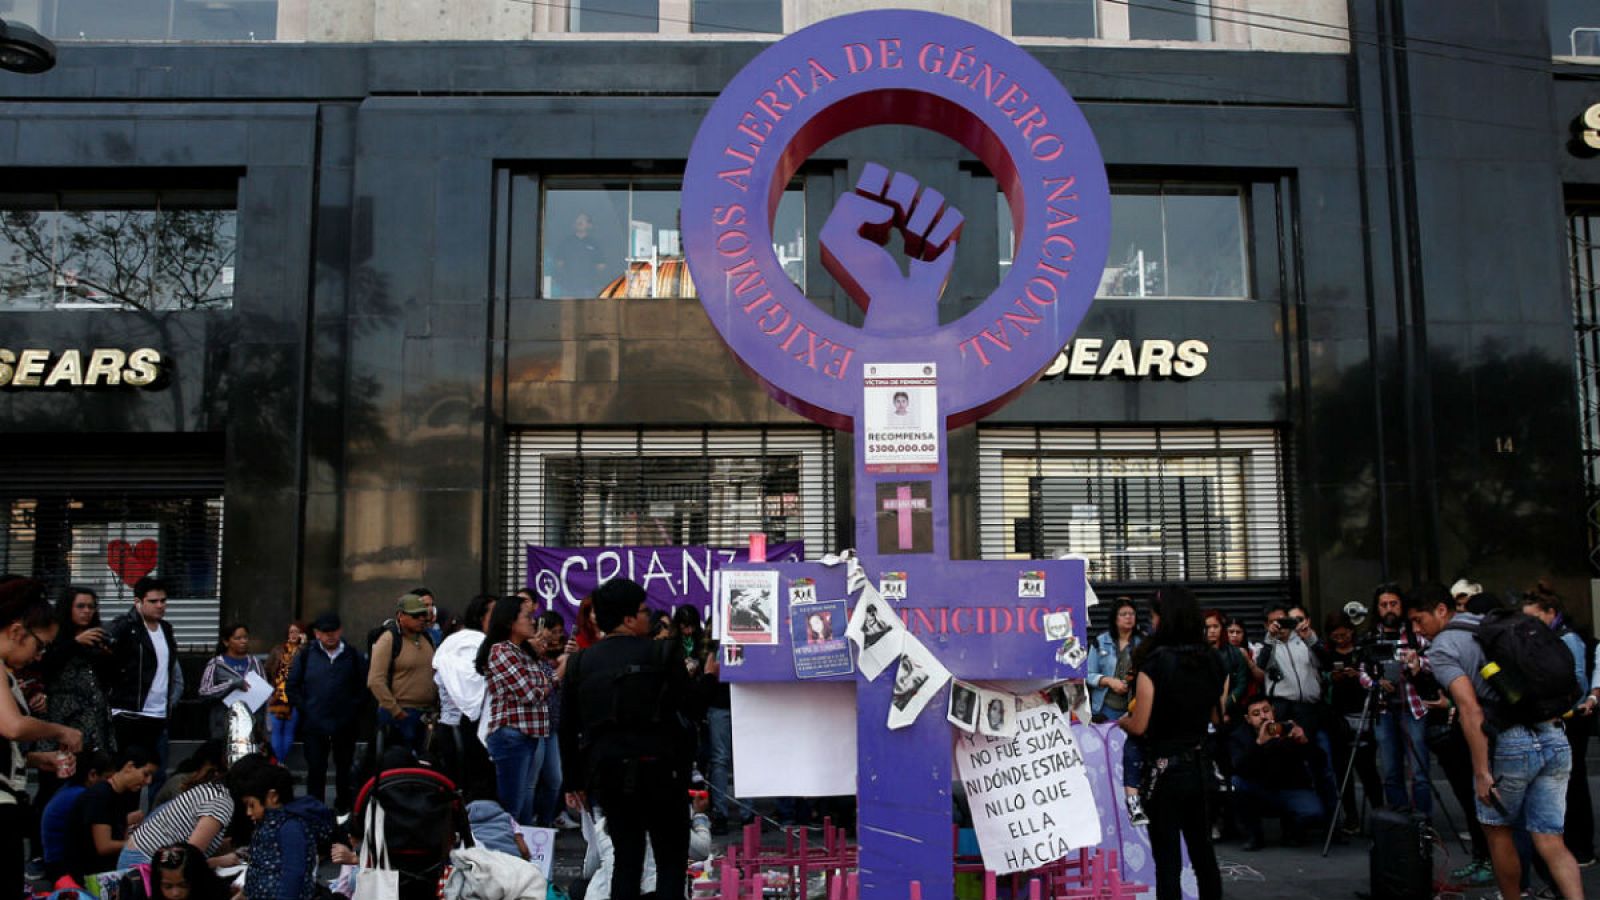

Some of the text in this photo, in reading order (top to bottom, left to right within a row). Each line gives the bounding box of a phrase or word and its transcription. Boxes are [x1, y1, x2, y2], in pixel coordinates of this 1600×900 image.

[714, 39, 1079, 381] EXIGIMOS ALERTA DE GÉNERO NACIONAL
[867, 431, 935, 441] RECOMPENSA
[868, 443, 936, 453] $300,000.00
[966, 780, 983, 796] NI
[1031, 749, 1084, 779] ESTABA
[969, 748, 992, 769] NO
[985, 780, 1072, 818] NI LO QUE
[1008, 812, 1056, 840] ELLA
[1004, 833, 1069, 870] HACÍA
